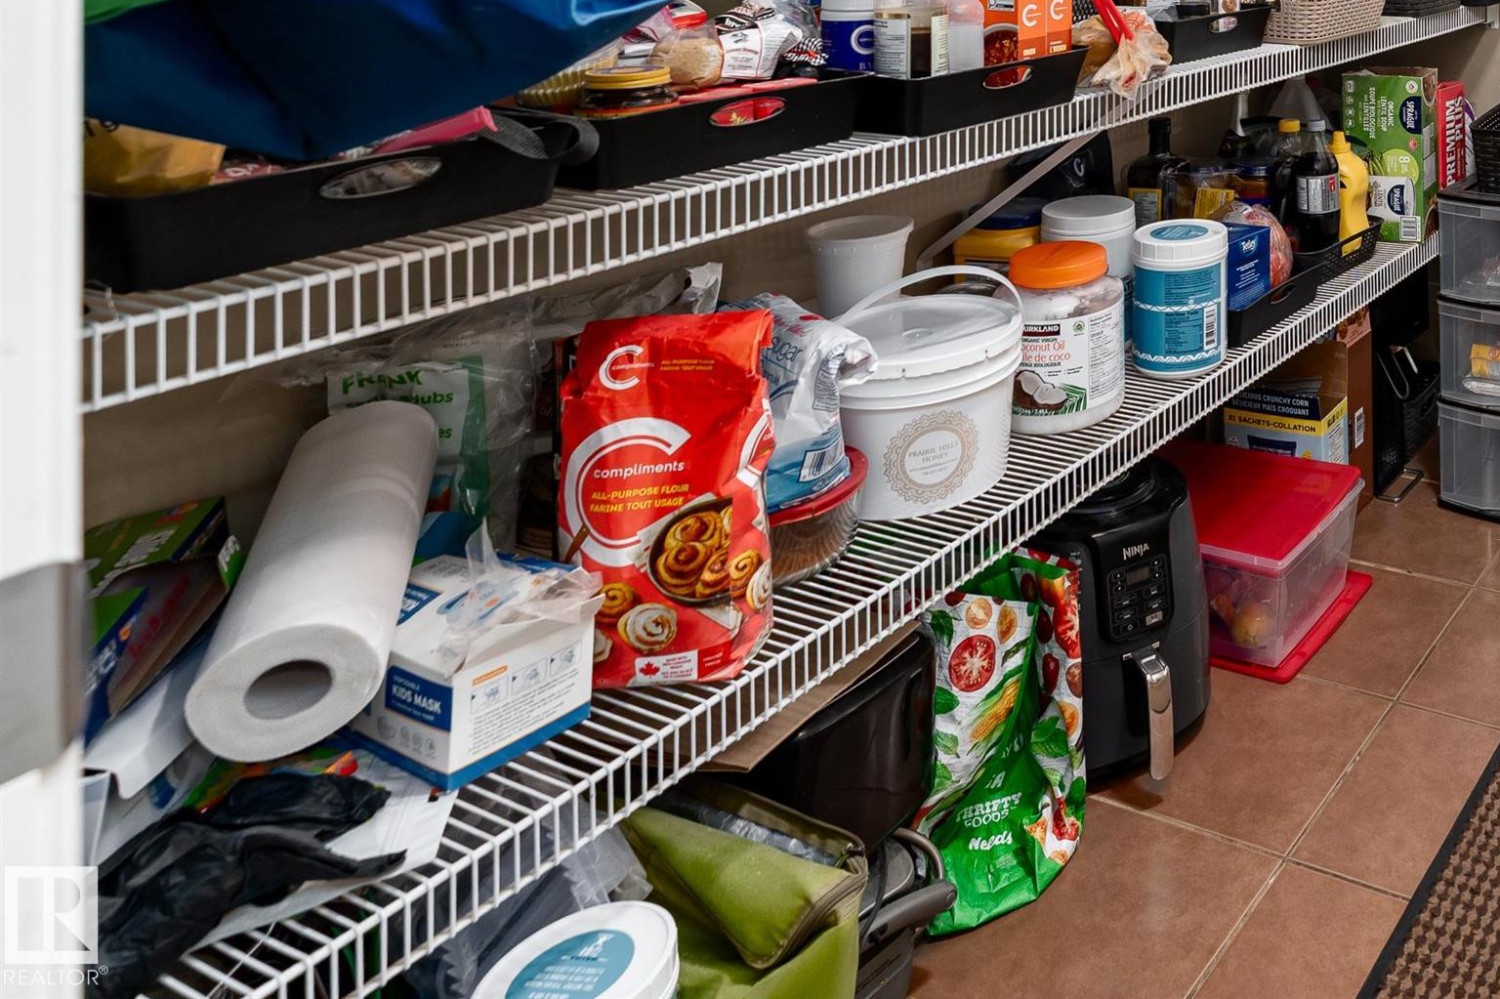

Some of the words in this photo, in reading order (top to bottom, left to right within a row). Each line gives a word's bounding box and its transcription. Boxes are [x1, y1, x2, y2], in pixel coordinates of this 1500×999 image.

[1406, 100, 1415, 129] SPRAGUE
[1454, 95, 1463, 141] PLUS
[1445, 99, 1456, 187] PREMIUM
[1053, 340, 1066, 351] Oil
[1034, 353, 1047, 362] de
[1048, 352, 1071, 361] coco
[1263, 394, 1291, 404] CRUNCHY
[1291, 398, 1309, 407] CORN
[1277, 406, 1309, 416] CROQUANT
[1238, 415, 1316, 432] SACHETS-COLLATION
[921, 451, 949, 463] HONEY
[593, 460, 685, 480] compliments
[591, 486, 659, 500] ALL-PURPOSE
[660, 483, 690, 495] FLOUR
[590, 501, 623, 513] FARINE
[626, 499, 653, 511] TOUT
[654, 497, 684, 509] USAGE
[1122, 542, 1150, 560] NINJA
[391, 683, 413, 702] KIDS
[413, 691, 442, 714] MASK
